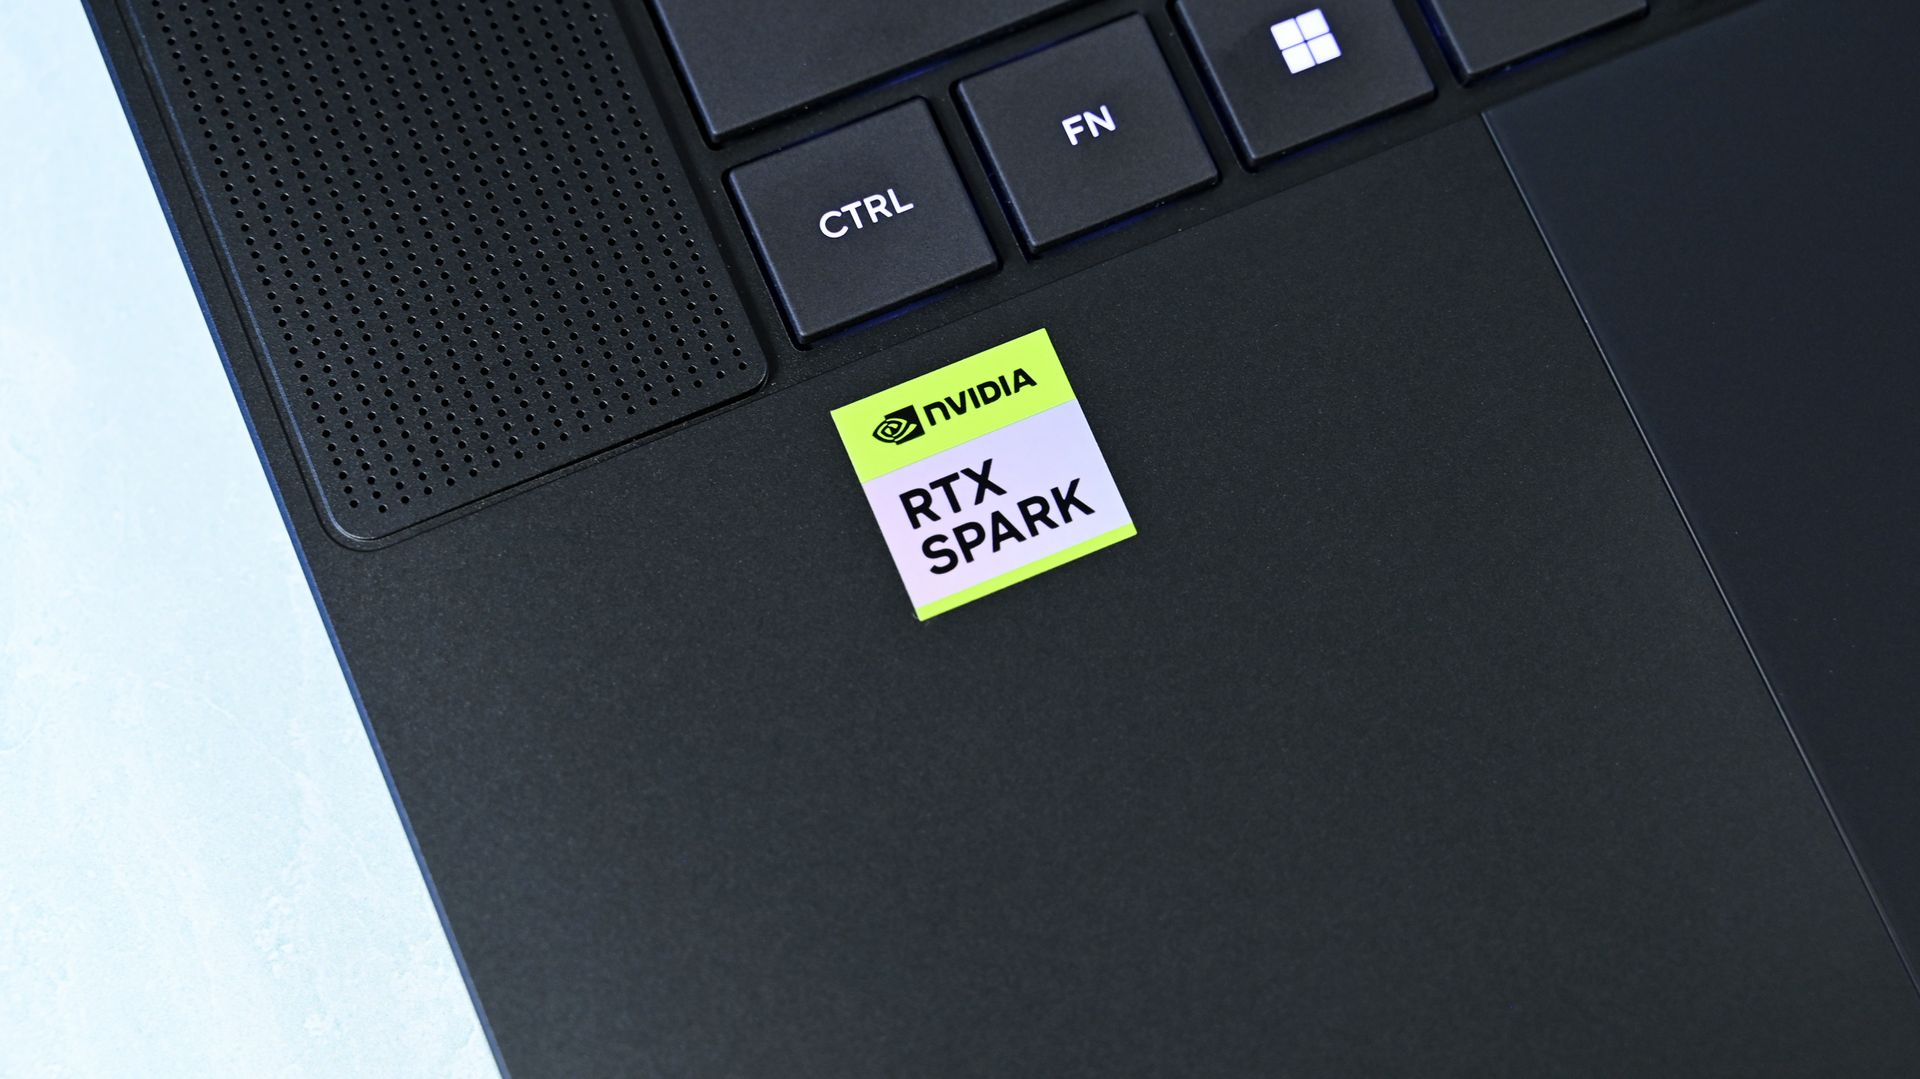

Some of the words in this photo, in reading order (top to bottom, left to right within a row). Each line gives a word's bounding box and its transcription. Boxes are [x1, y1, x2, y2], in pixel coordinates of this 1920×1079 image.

[1061, 104, 1117, 146] FN
[818, 188, 915, 239] CTRL
[898, 457, 1008, 530] RTX
[921, 477, 1096, 575] SPARK
